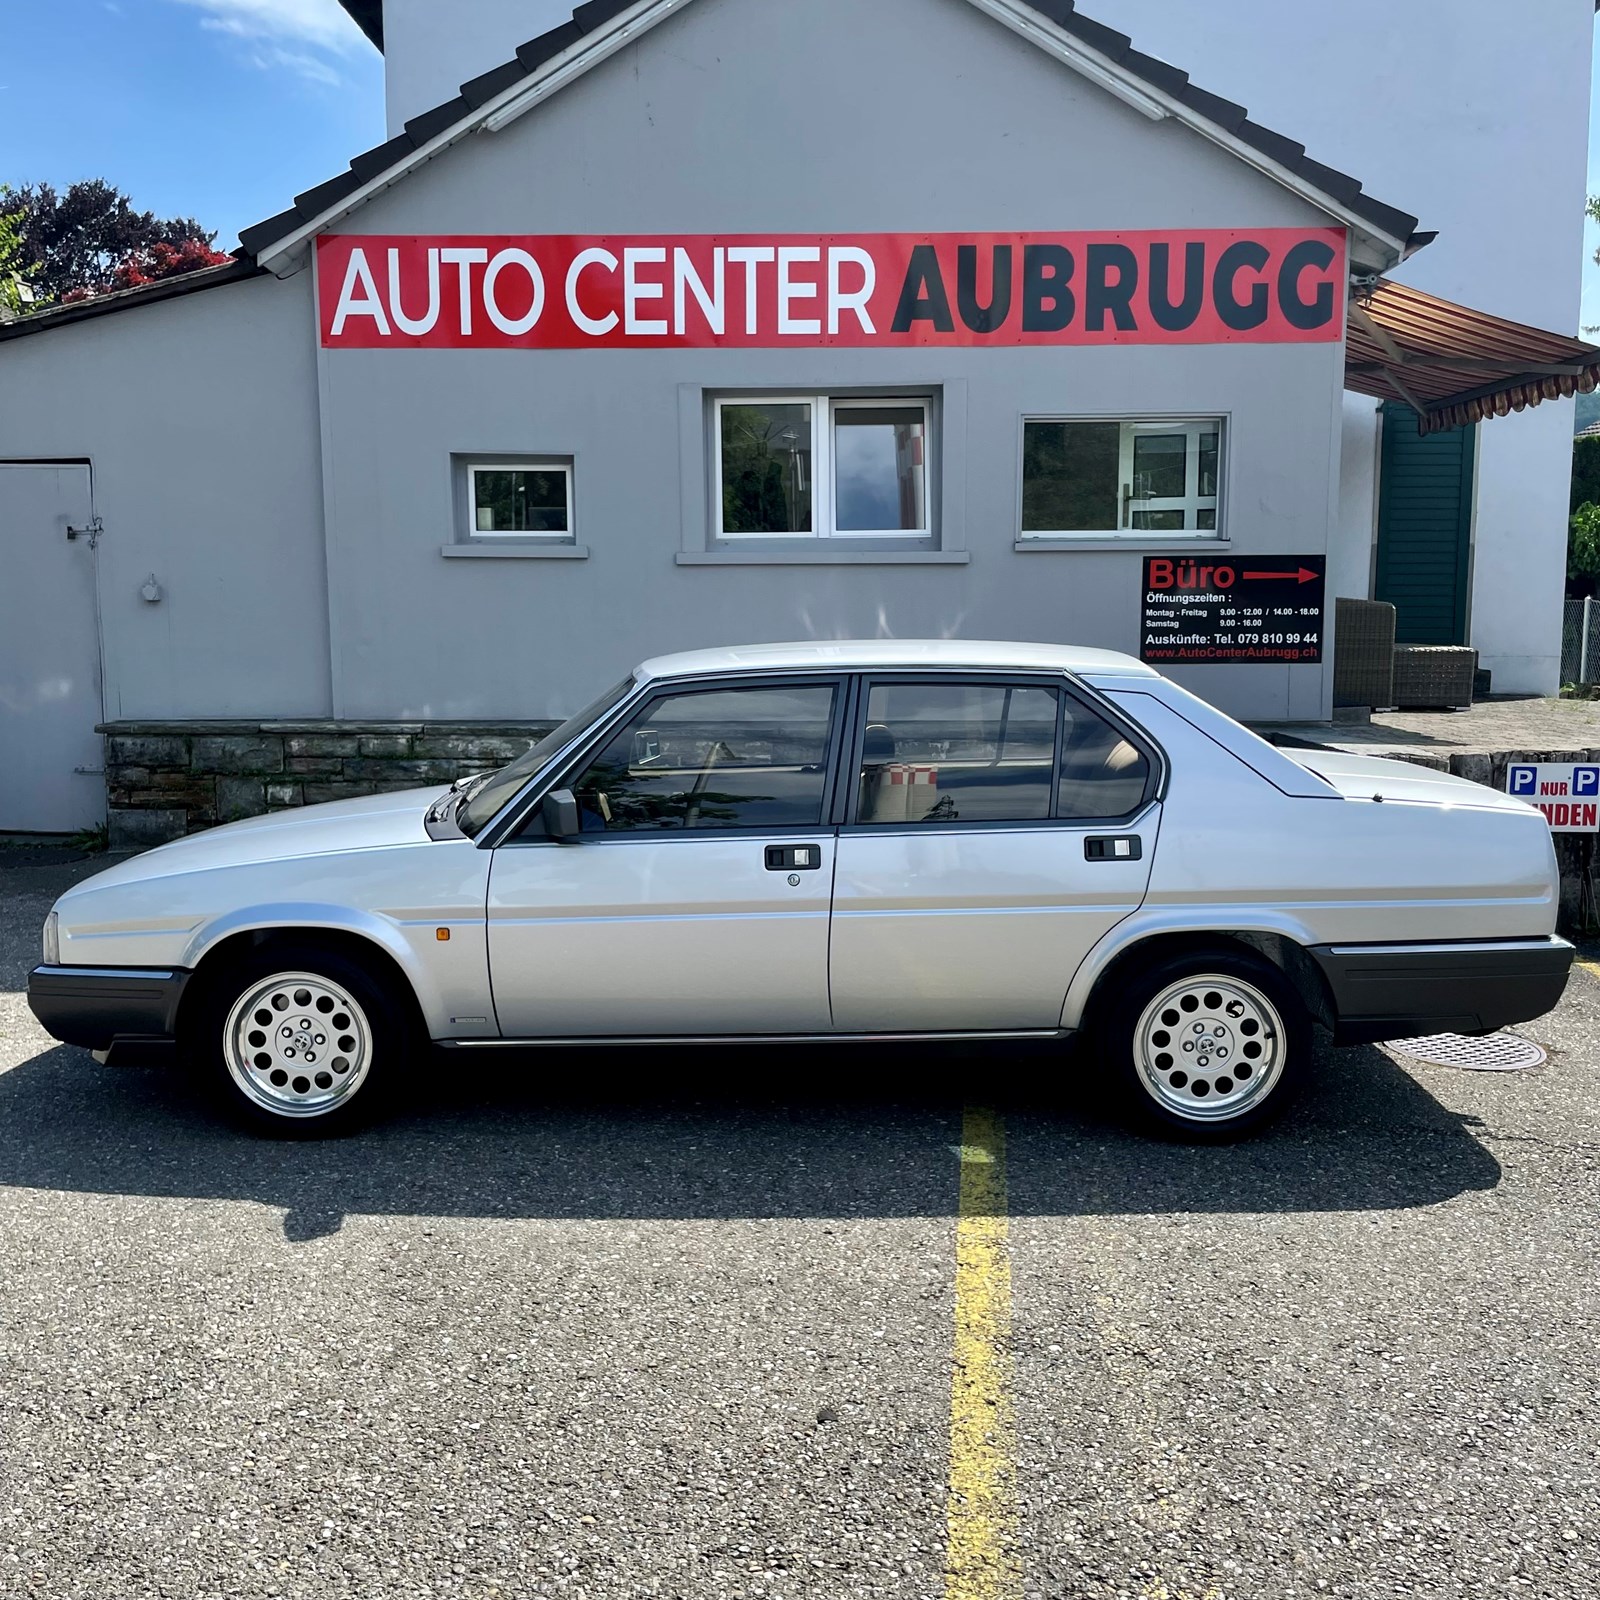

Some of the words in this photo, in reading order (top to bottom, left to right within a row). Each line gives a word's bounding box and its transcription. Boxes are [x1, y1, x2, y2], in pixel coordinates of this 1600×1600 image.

[330, 247, 546, 336] AUTO
[565, 246, 877, 336] CENTER
[890, 240, 1336, 334] AUBRUGG
[1149, 559, 1236, 588] Büro
[1146, 591, 1226, 605] Öffnungszeiten
[1146, 609, 1175, 618] Montag
[1181, 608, 1208, 618] Freitag
[1242, 608, 1262, 616] 12.00
[1300, 608, 1319, 616] 18.00
[1146, 620, 1180, 628] Samstag
[1145, 634, 1210, 644] Auskünfte:
[1214, 634, 1234, 644] Tel.
[1238, 634, 1259, 644] 079
[1262, 633, 1283, 644] 810
[1286, 633, 1300, 643] 99
[1302, 632, 1318, 644] 44
[1145, 646, 1318, 659] www.AutoCenterAubrugg.ch
[1514, 770, 1534, 792] P
[1540, 782, 1568, 796] NUR
[1577, 770, 1596, 792] P
[1529, 804, 1597, 826] NDEN
